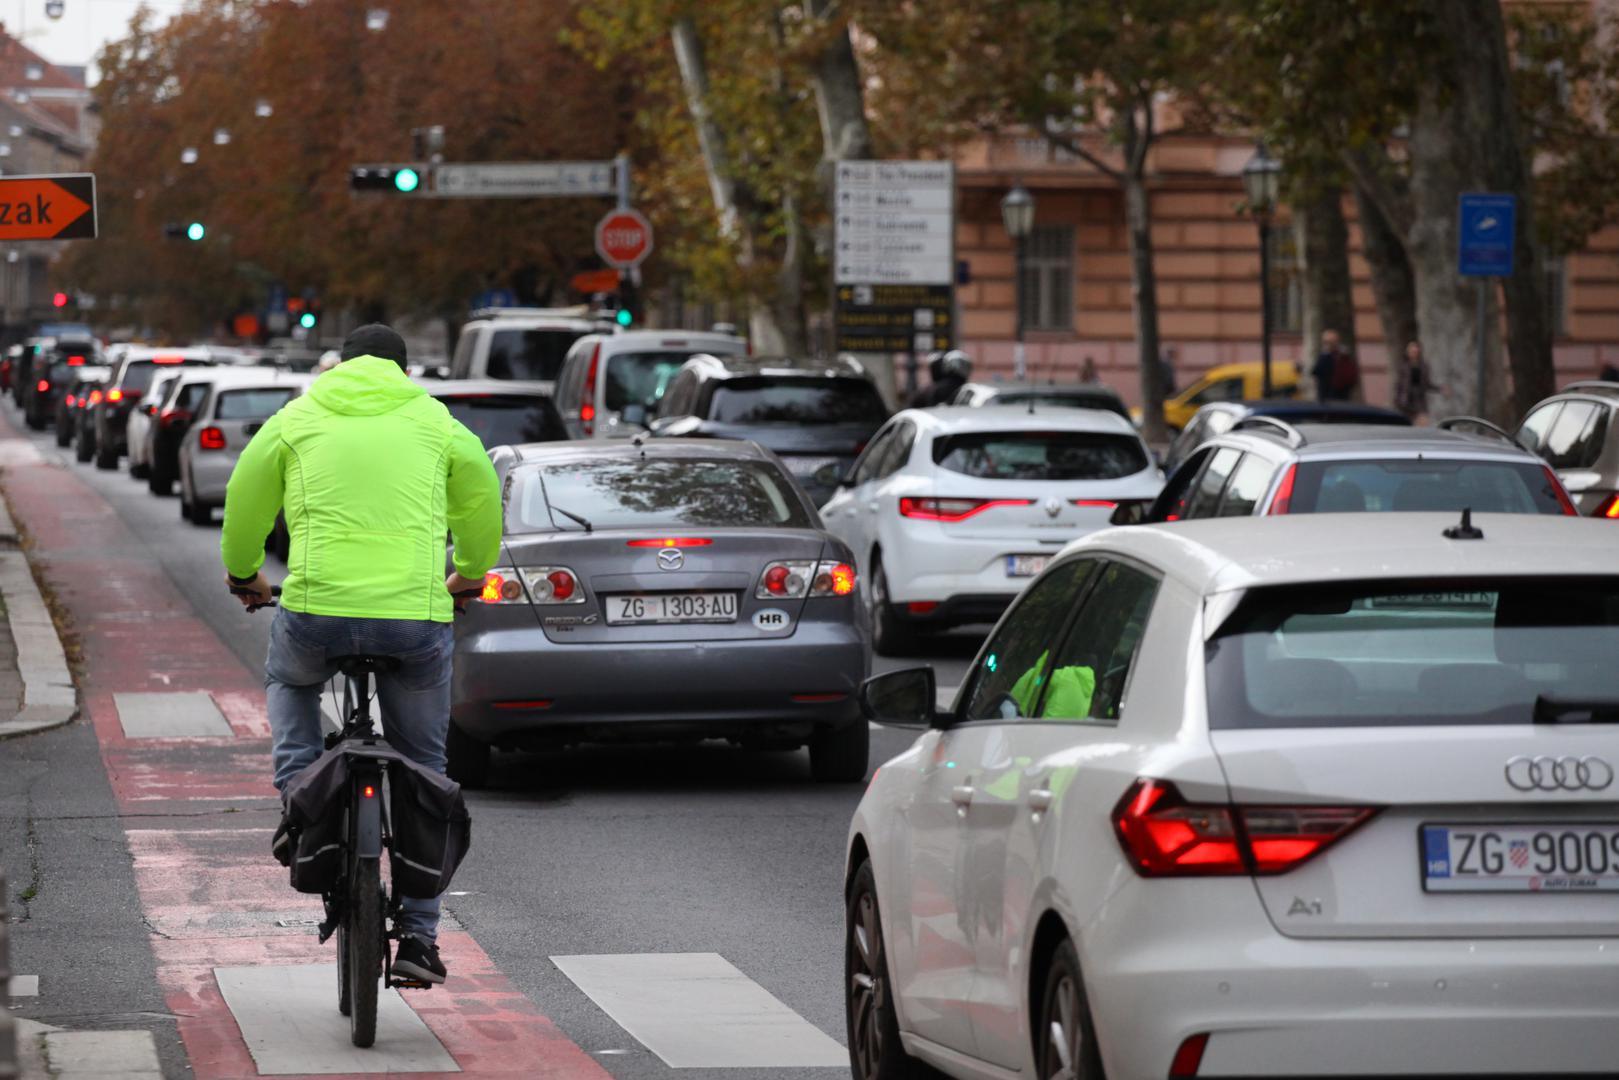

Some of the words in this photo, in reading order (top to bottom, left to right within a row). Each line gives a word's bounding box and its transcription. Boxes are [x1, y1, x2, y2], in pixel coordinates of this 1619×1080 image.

[0, 193, 52, 224] zak
[608, 229, 641, 248] STOP
[621, 598, 645, 618] ZG
[759, 613, 782, 624] HR
[1454, 832, 1504, 874] ZG
[1428, 860, 1448, 873] HR
[1286, 896, 1322, 917] A1
